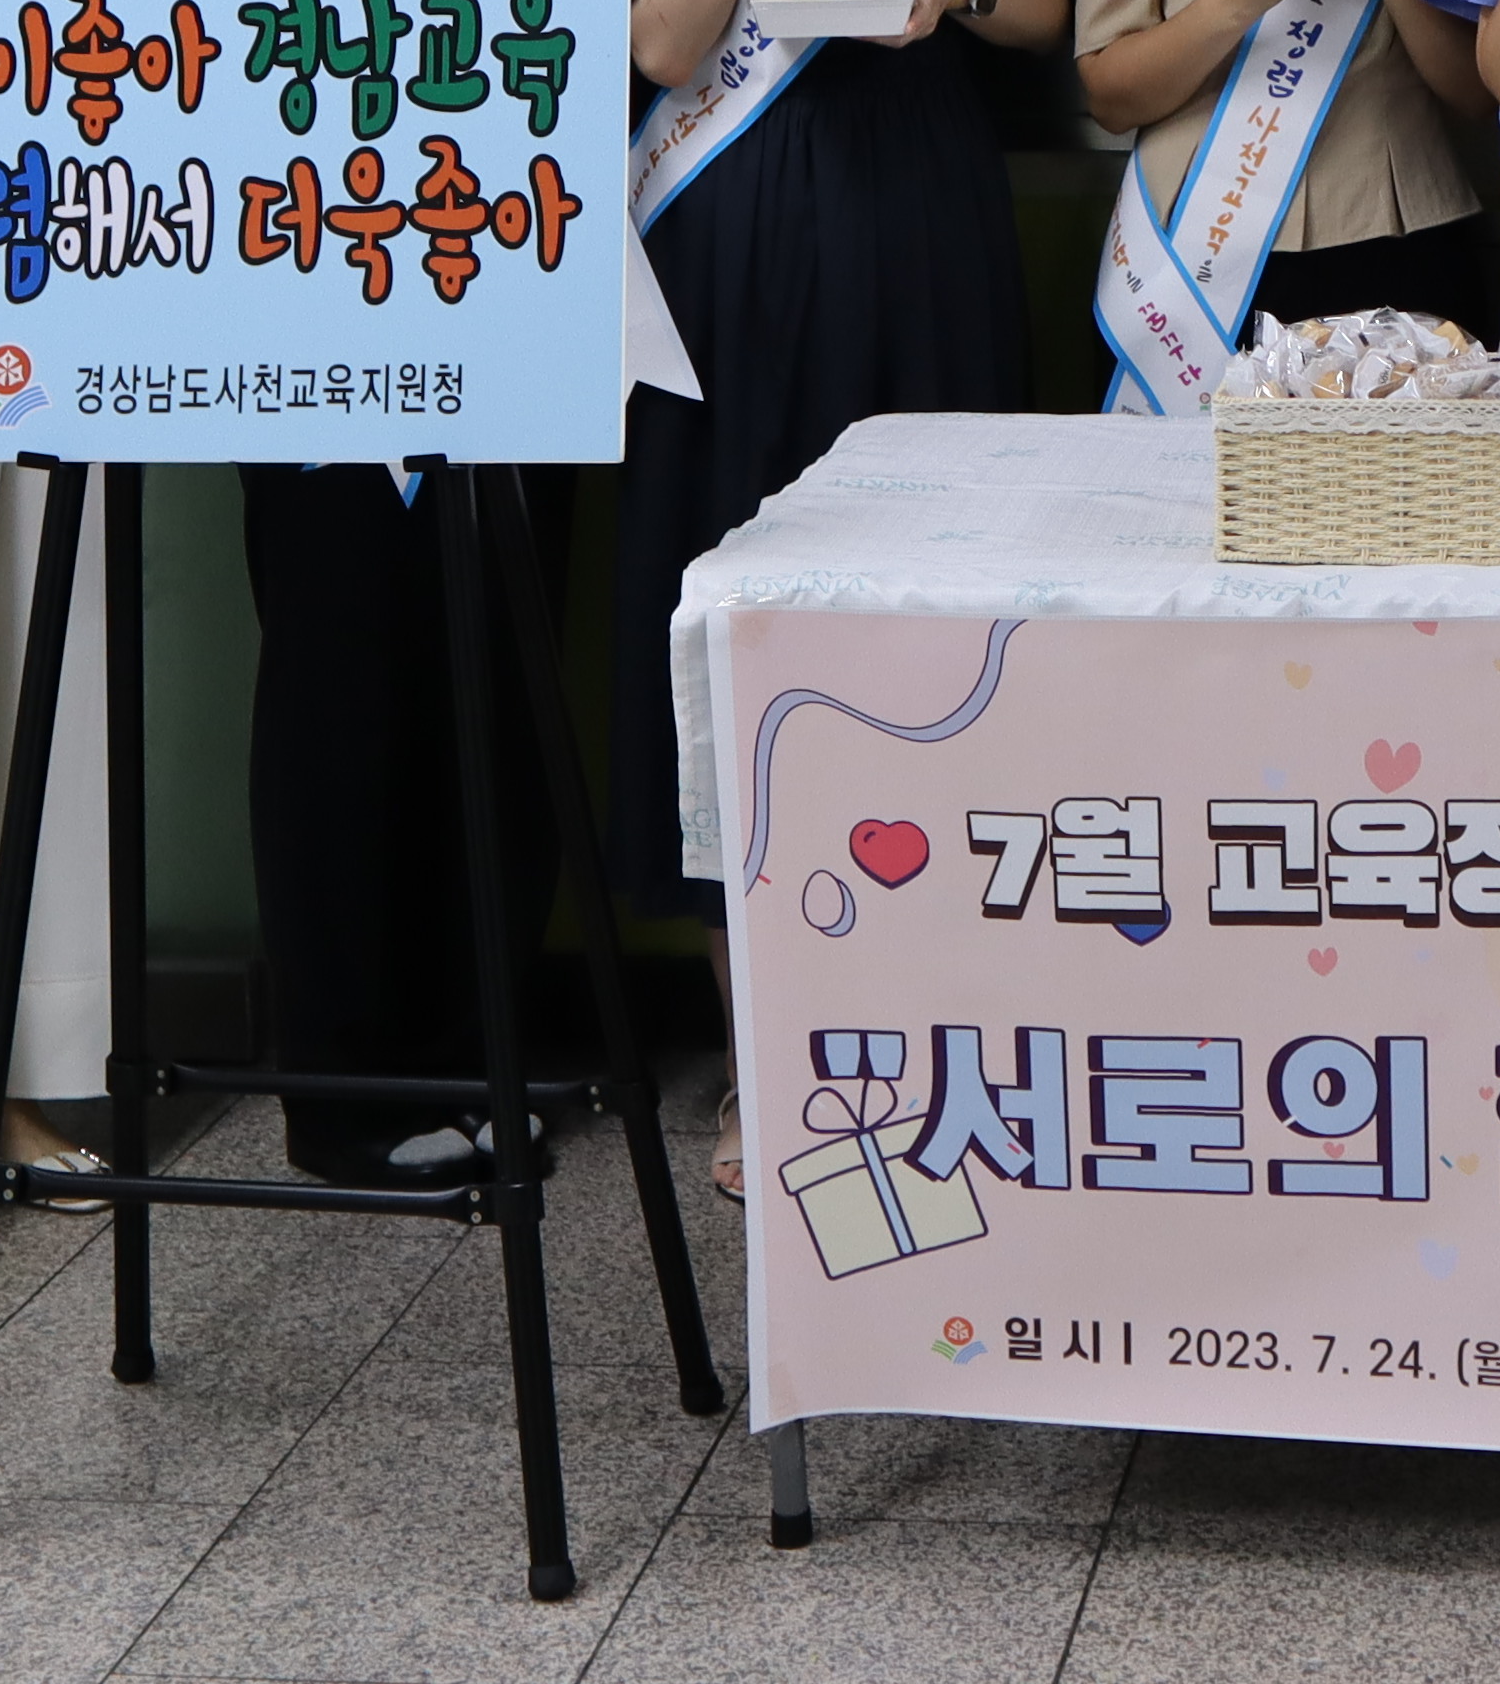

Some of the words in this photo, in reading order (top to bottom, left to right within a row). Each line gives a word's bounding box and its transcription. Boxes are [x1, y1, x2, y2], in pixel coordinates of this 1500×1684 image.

[1265, 19, 1324, 99] 청렴
[632, 84, 726, 206] 사천교육
[1196, 106, 1282, 284] 사천교육을
[238, 134, 582, 305] 더욱좋아
[73, 362, 465, 415] 경상남도사천교육지원청
[1138, 301, 1203, 386] 꿈꾸다
[966, 795, 1171, 926] 7월
[1165, 1325, 1293, 1374] 2023.
[1311, 1332, 1350, 1378] 7.
[1368, 1335, 1437, 1381] 24.
